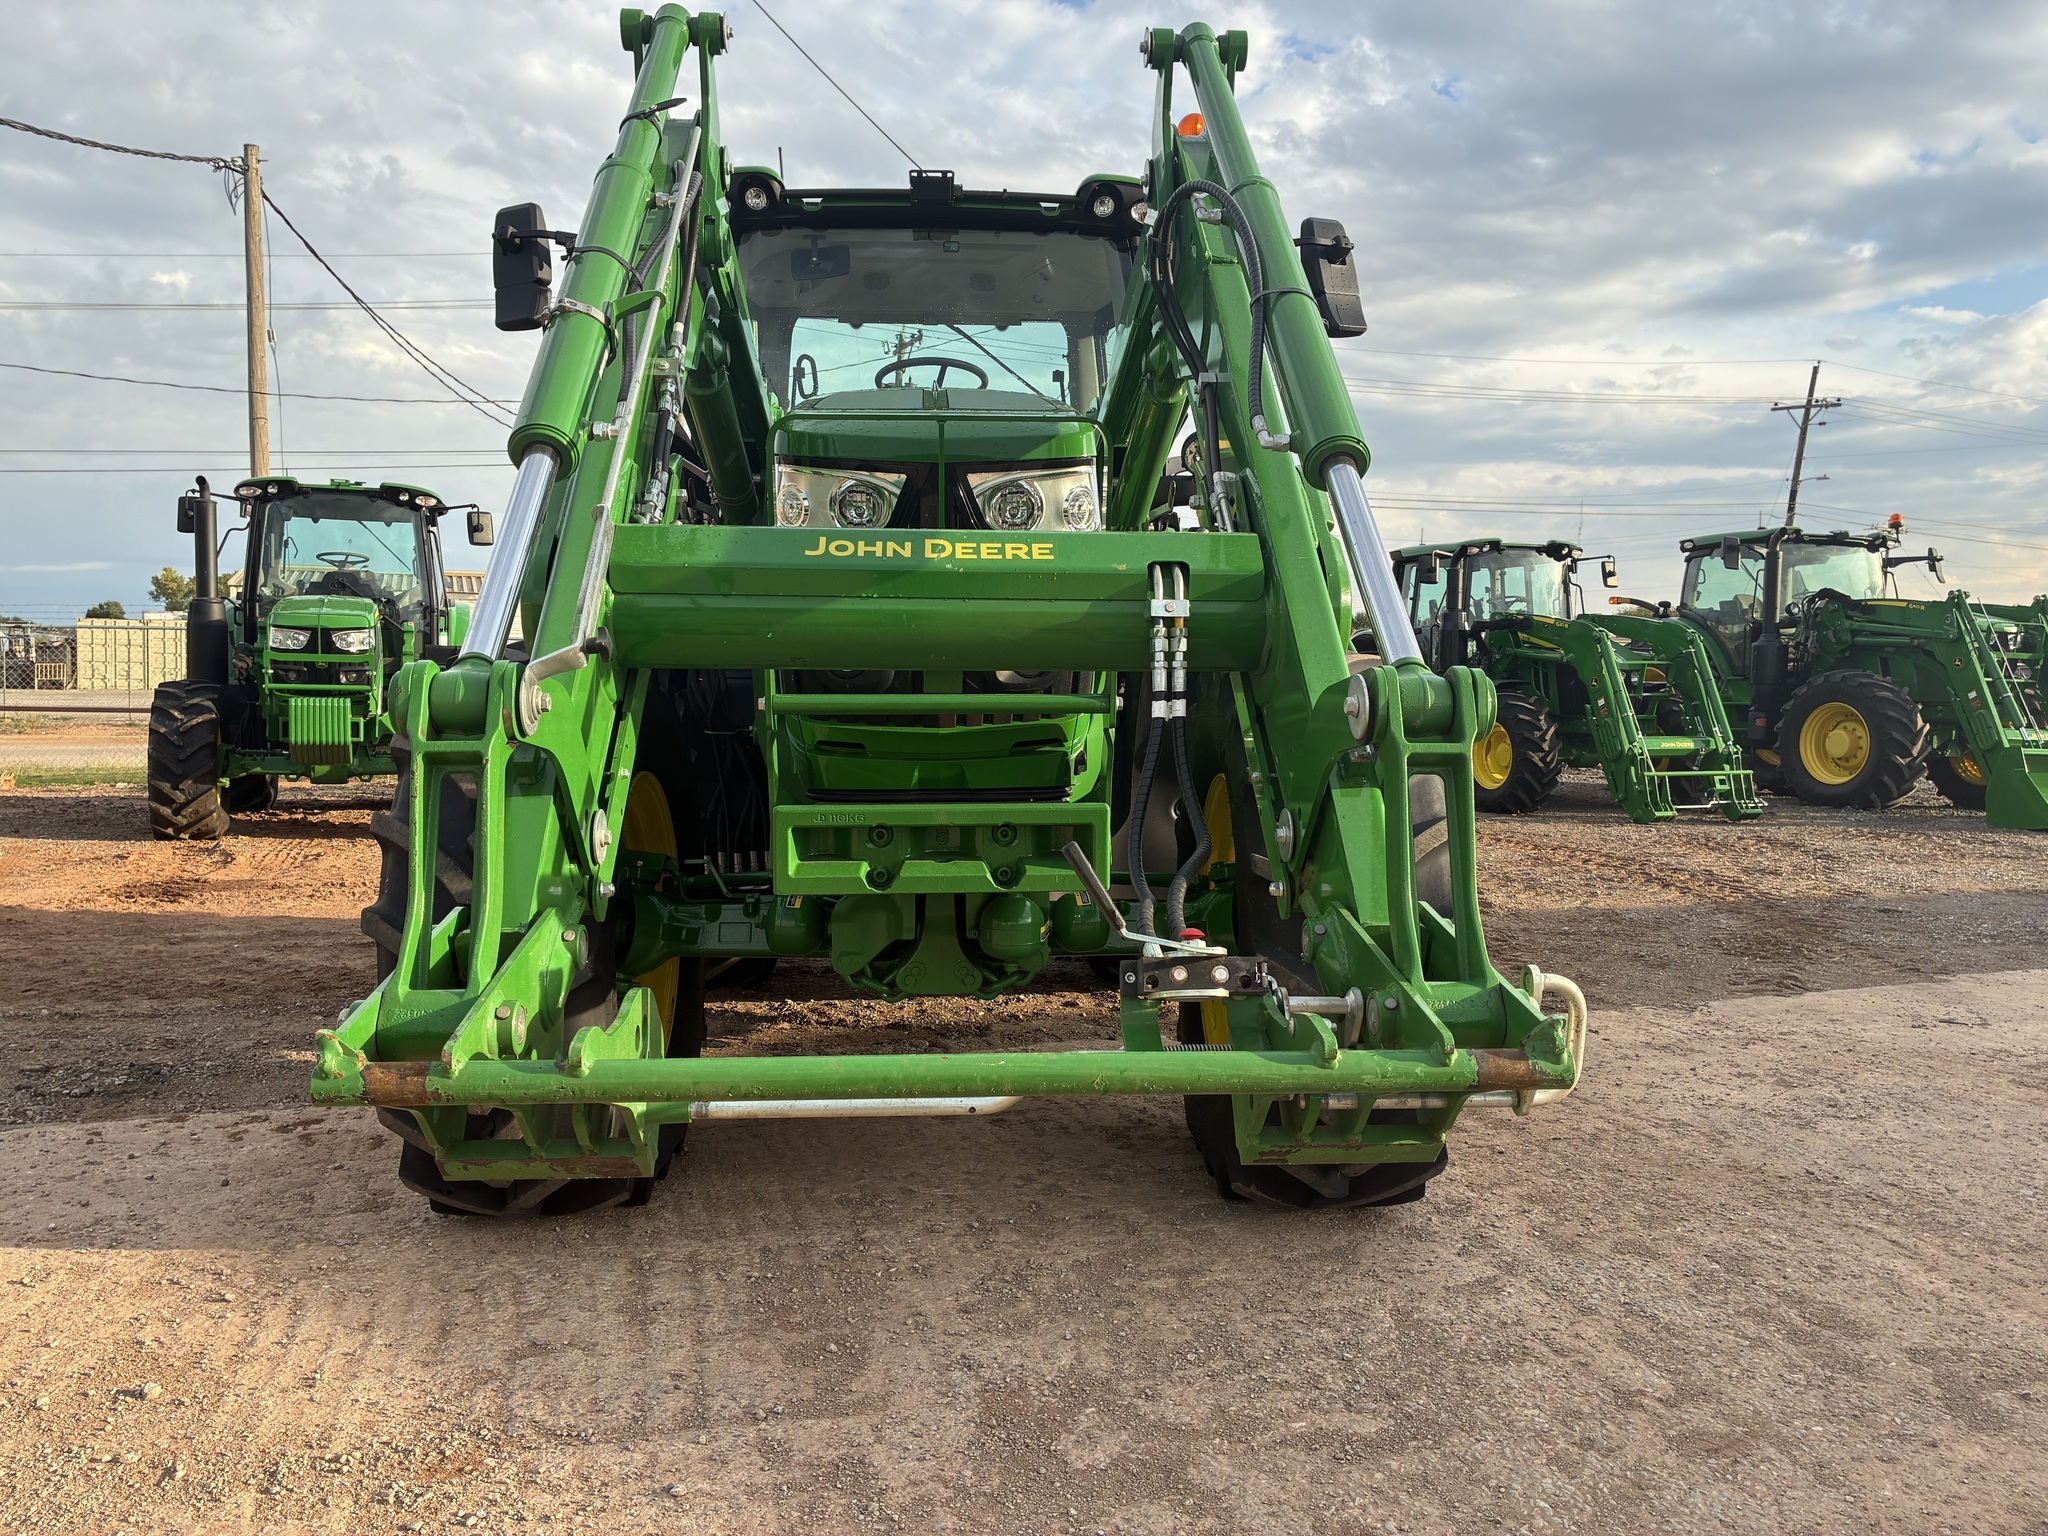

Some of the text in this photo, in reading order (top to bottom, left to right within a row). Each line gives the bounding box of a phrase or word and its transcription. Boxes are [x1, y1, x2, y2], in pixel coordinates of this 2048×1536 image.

[804, 536, 1055, 560] JOHN DEERE
[829, 813, 866, 823] 110KG
